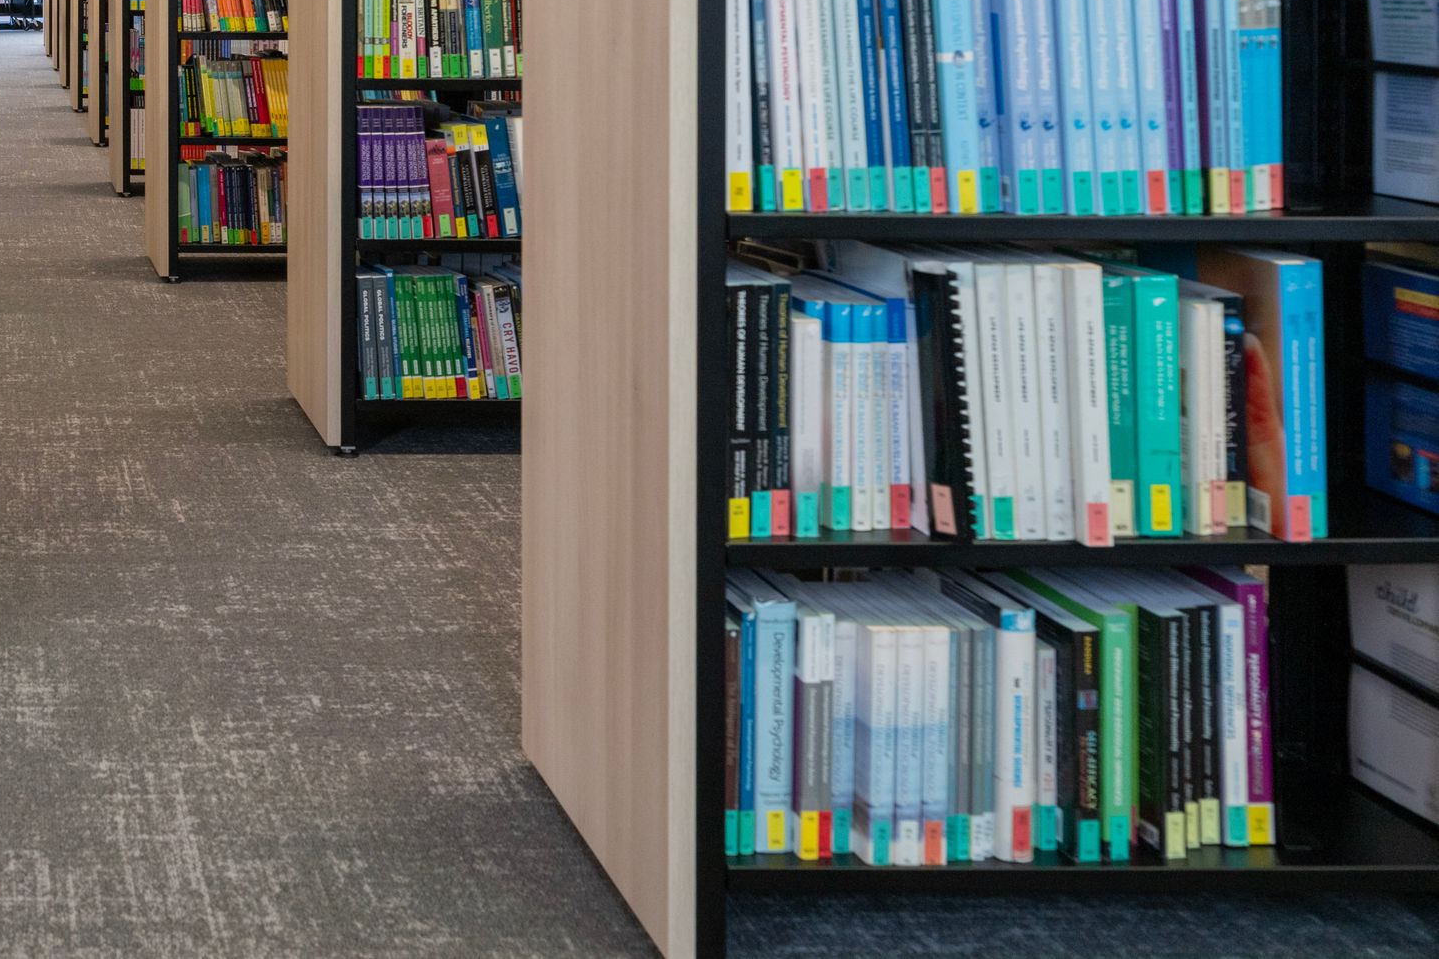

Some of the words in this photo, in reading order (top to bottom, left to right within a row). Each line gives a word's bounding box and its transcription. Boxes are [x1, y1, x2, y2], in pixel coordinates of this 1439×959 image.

[781, 47, 791, 102] PSYCHOLOGY
[757, 295, 768, 327] Theories
[777, 293, 788, 327] Theories
[503, 323, 514, 343] CRY
[506, 347, 518, 374] HAVO
[758, 342, 768, 374] Human
[778, 341, 787, 371] Human
[755, 376, 768, 432] Development
[775, 374, 787, 428] Development
[771, 632, 785, 716] Developmental
[769, 719, 785, 781] Psychology
